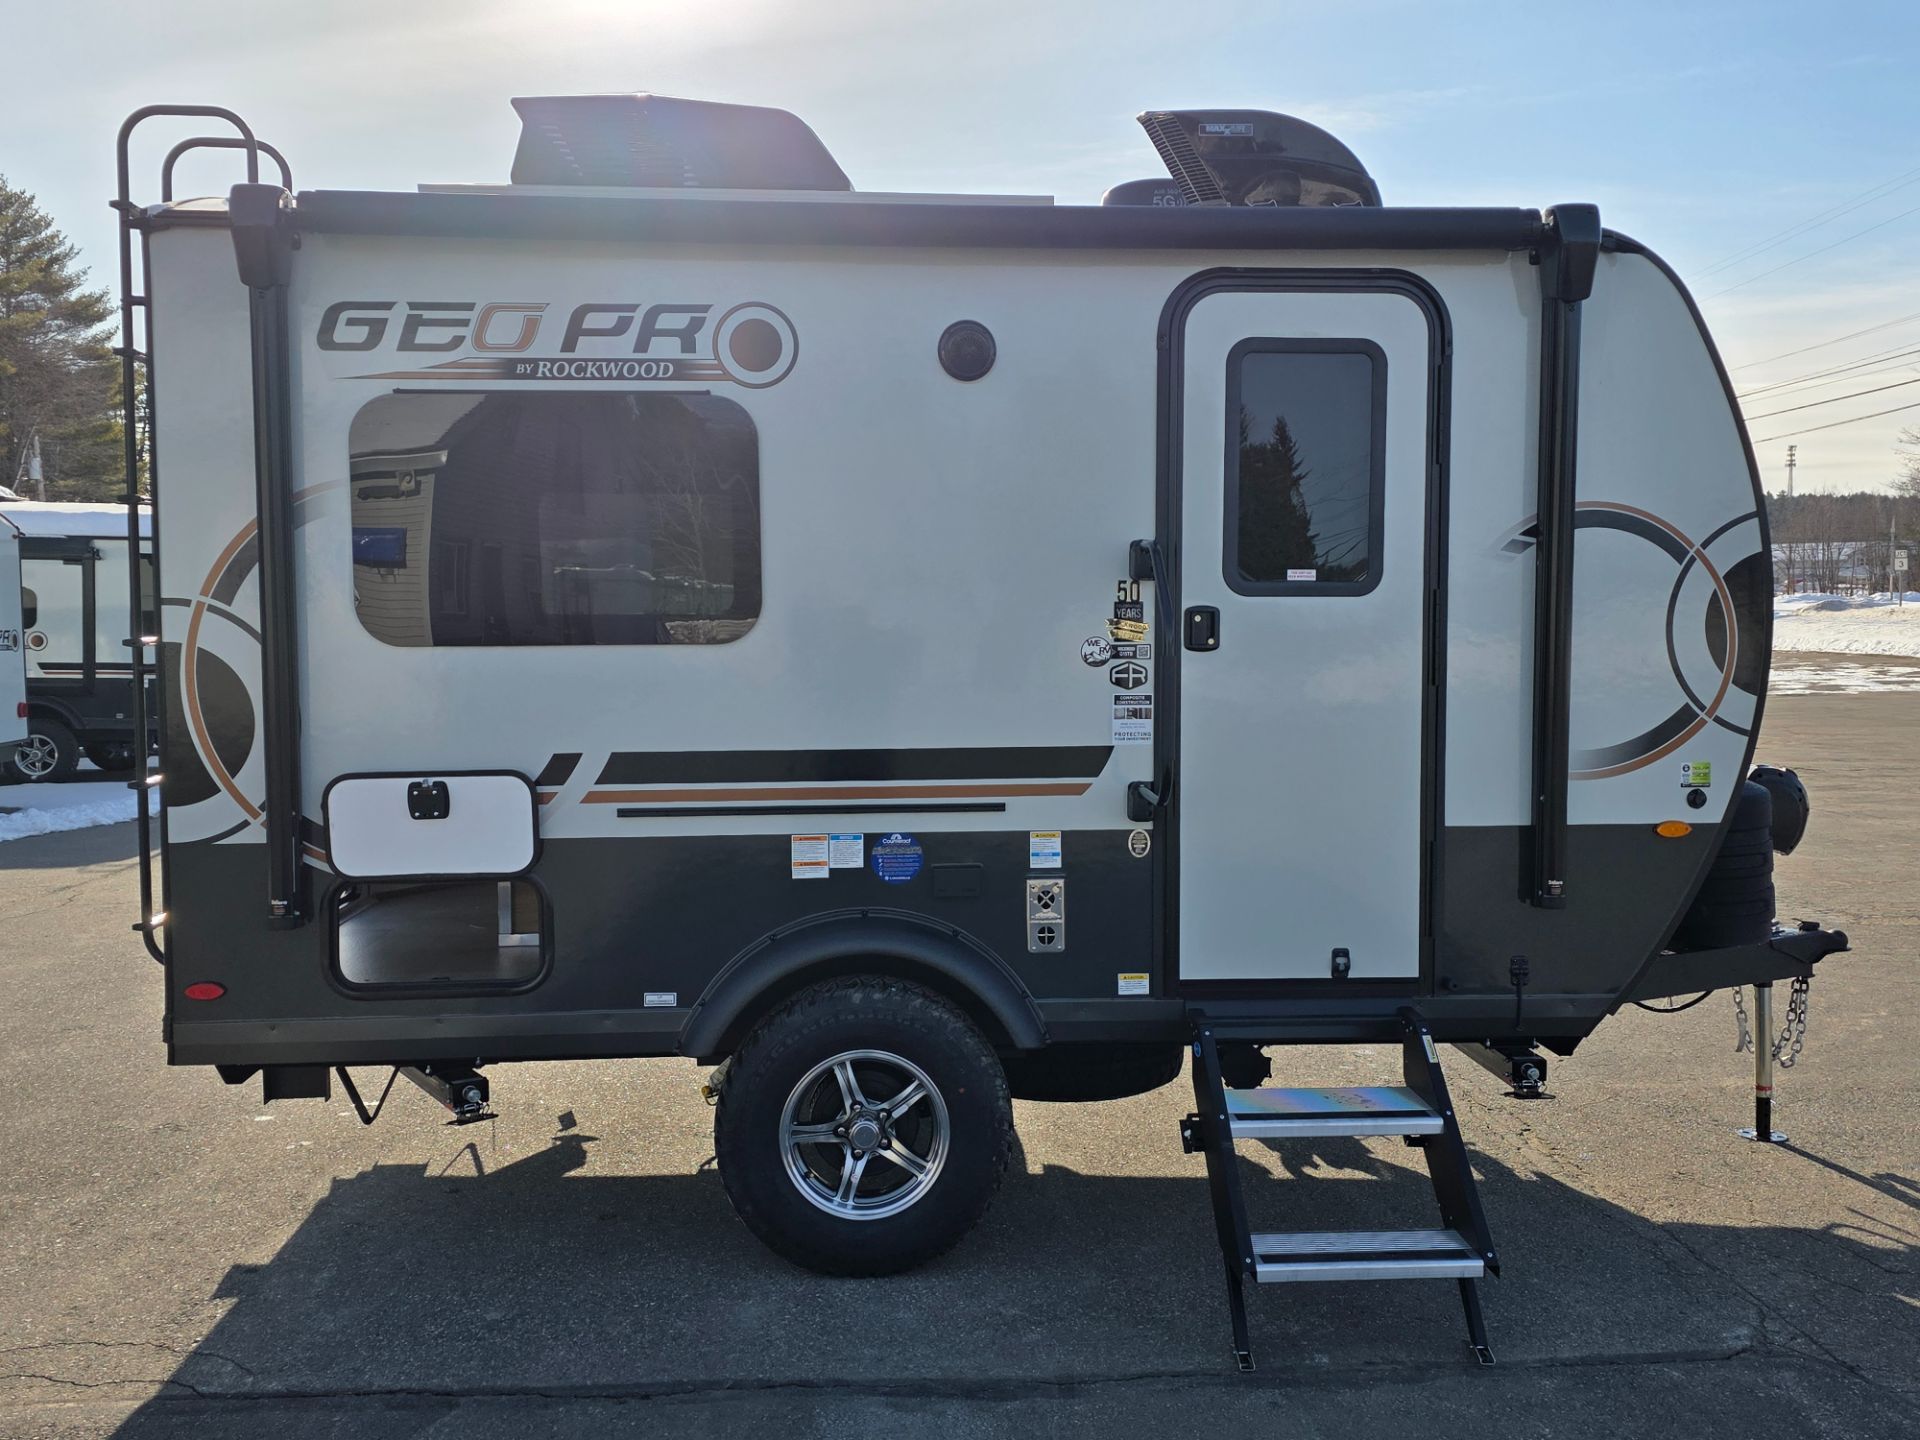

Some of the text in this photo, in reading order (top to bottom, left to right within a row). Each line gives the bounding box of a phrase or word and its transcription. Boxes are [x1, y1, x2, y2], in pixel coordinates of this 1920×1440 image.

[1153, 195, 1176, 208] 5G
[316, 301, 550, 352] GEO
[516, 361, 674, 379] BY ROCKWOOD
[1117, 580, 1140, 602] 50
[1116, 608, 1142, 619] YEARS
[1086, 639, 1101, 647] WE
